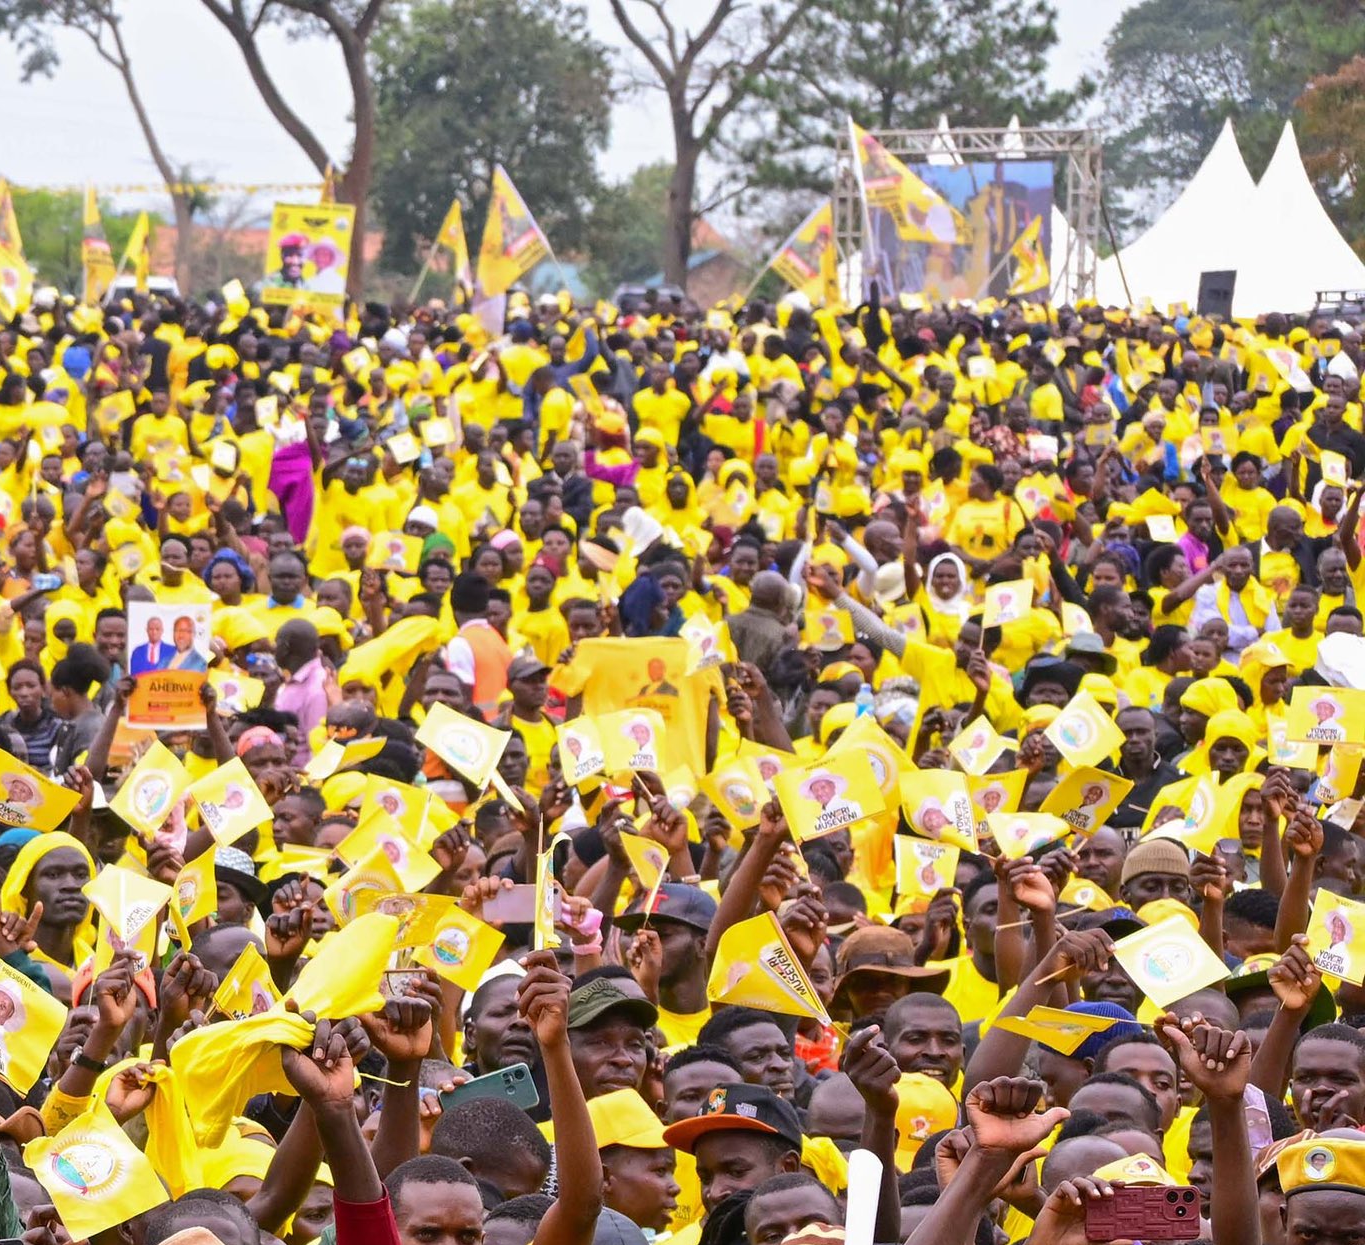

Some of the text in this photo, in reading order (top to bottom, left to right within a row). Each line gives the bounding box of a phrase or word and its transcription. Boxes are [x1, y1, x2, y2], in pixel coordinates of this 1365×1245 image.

[814, 812, 858, 832] MUSEVENI
[816, 807, 851, 823] YOWERI
[772, 947, 807, 997] MUSEVENI
